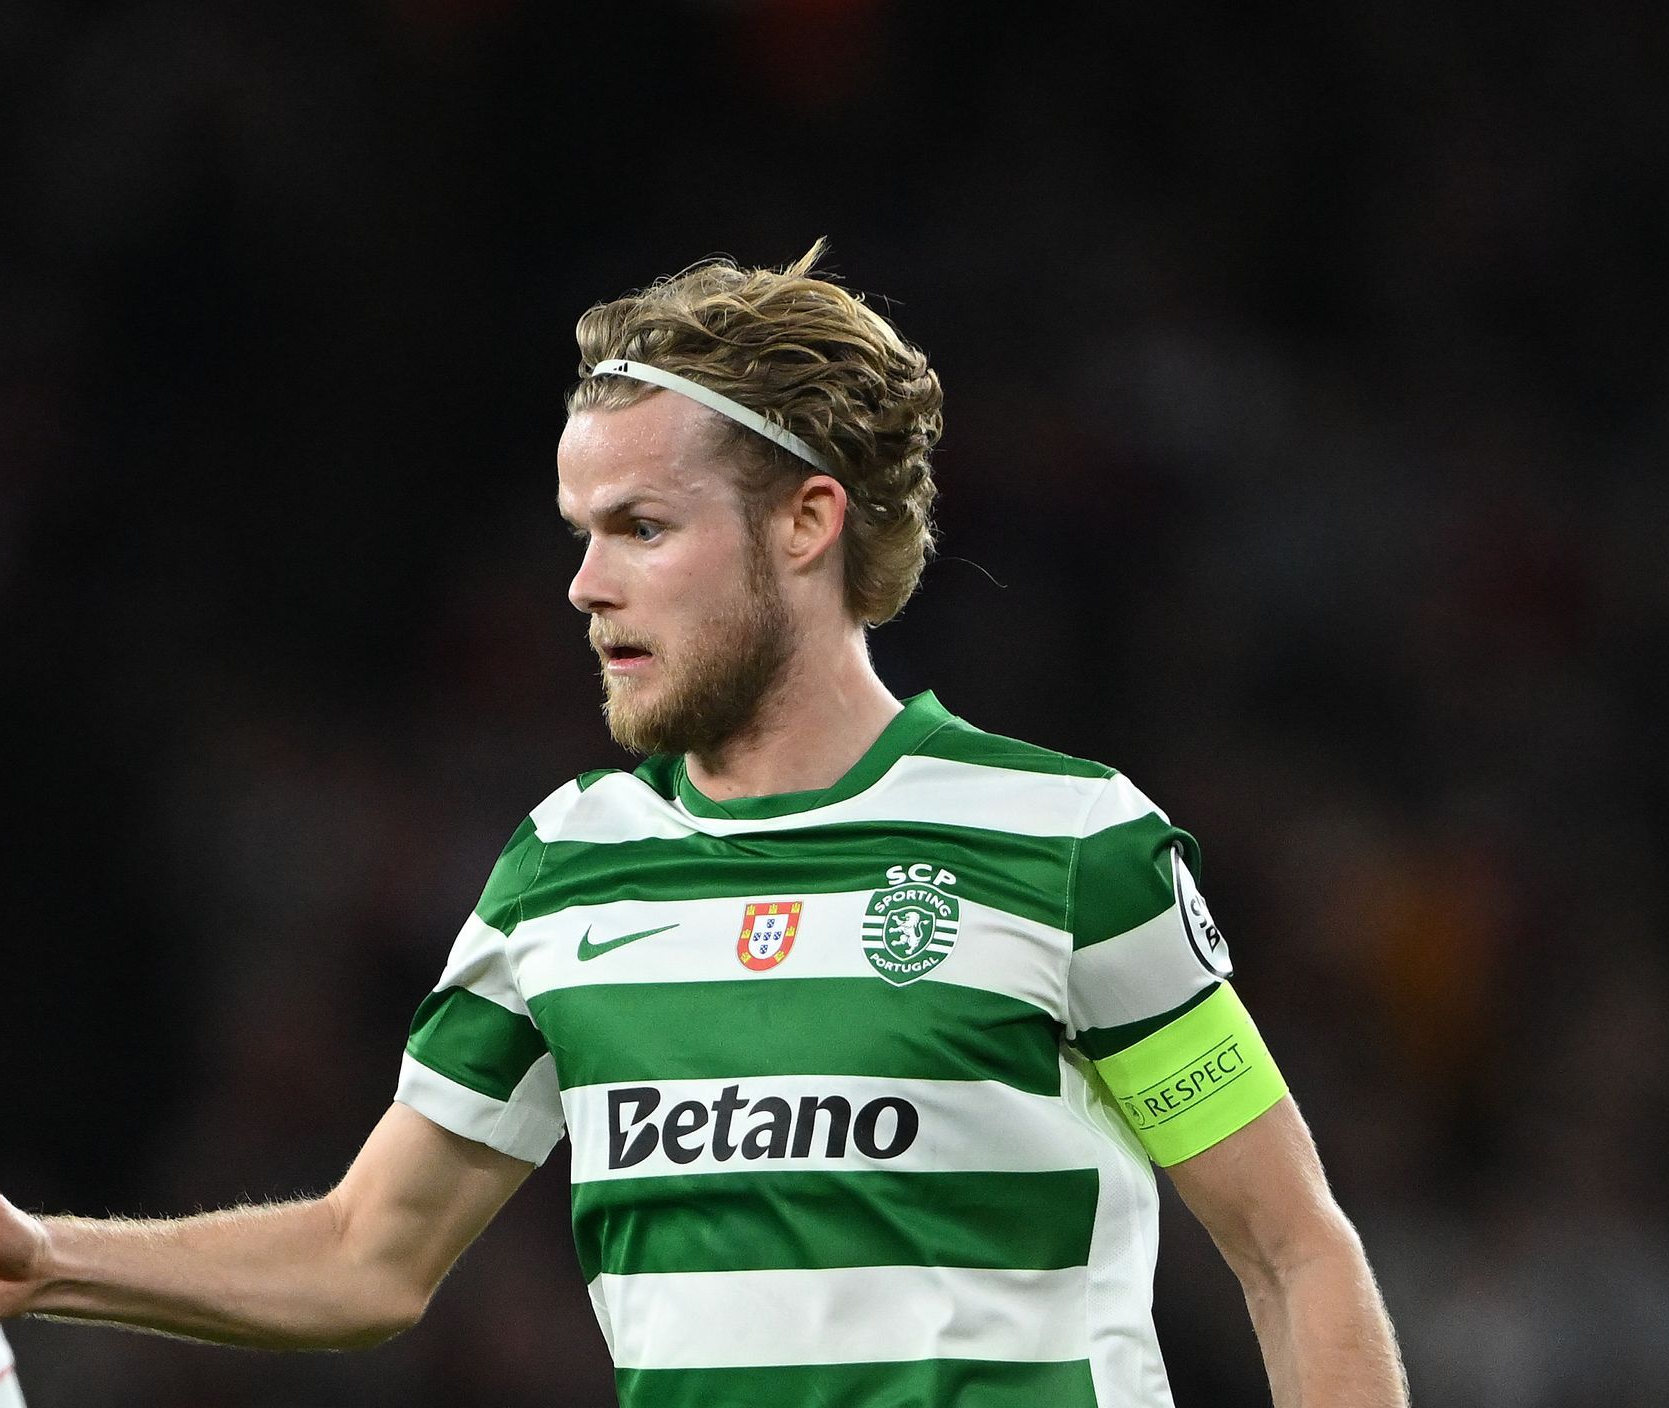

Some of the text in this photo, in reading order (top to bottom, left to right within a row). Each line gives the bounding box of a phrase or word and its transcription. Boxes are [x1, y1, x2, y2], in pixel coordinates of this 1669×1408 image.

[885, 863, 957, 886] SCP
[873, 889, 952, 918] SPORTING
[869, 952, 939, 973] PORTUGAL
[1143, 1043, 1247, 1118] RESPECT
[607, 1084, 920, 1170] Betano
